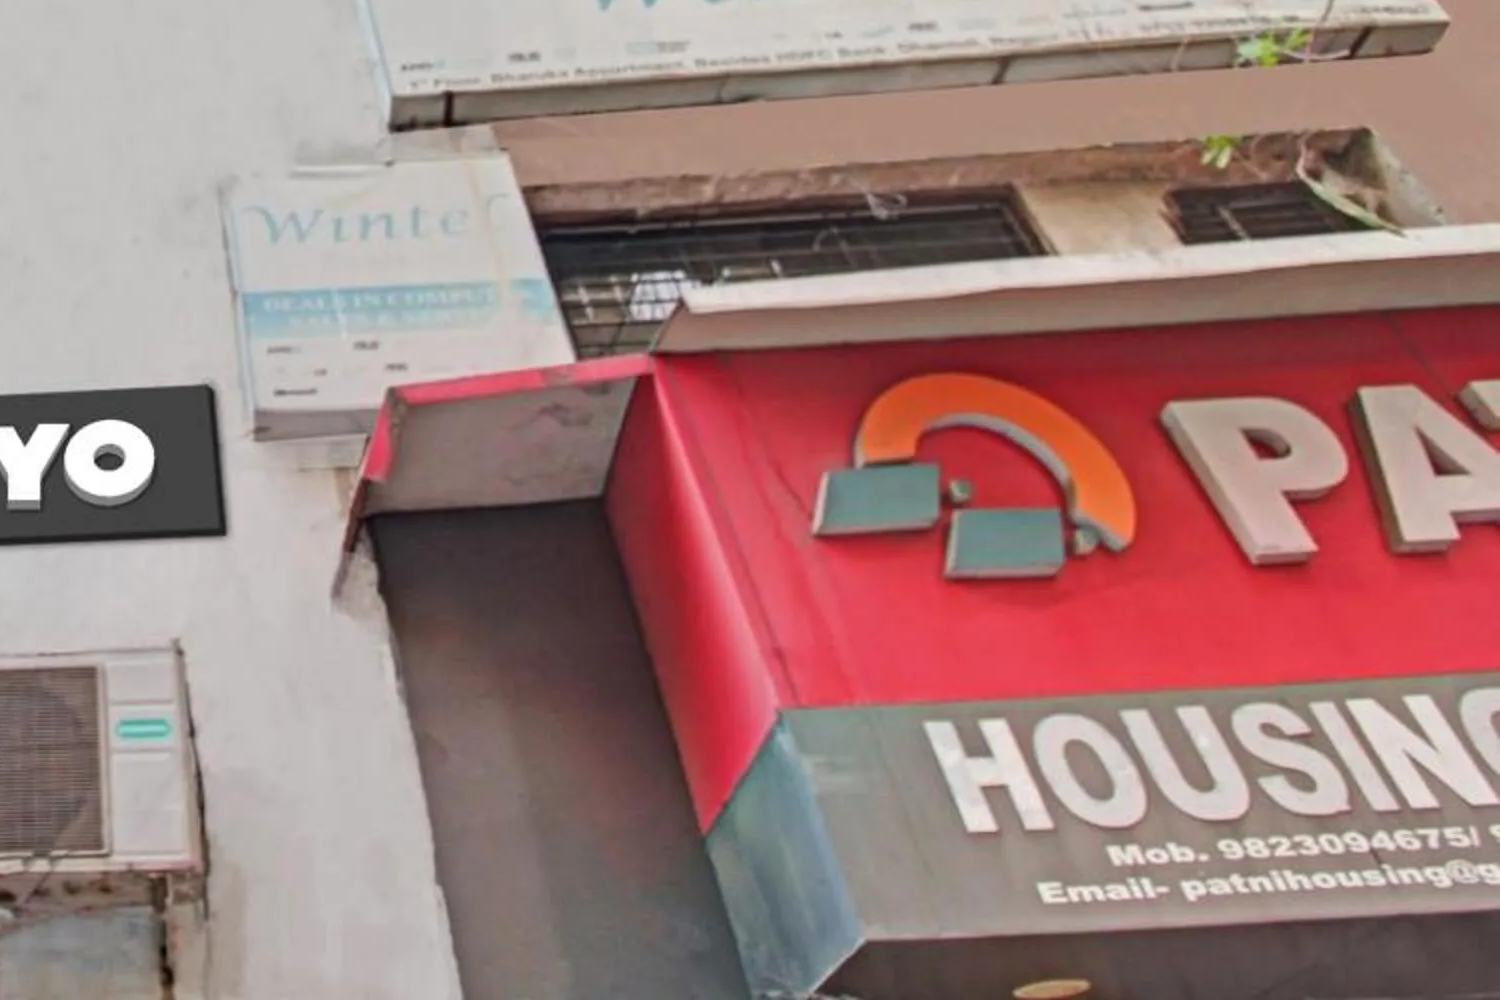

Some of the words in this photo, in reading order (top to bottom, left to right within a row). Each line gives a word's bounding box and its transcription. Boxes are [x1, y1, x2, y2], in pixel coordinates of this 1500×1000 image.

[1159, 378, 1500, 566] PA
[1106, 843, 1209, 868] Mob.
[1037, 876, 1169, 905] Email-
